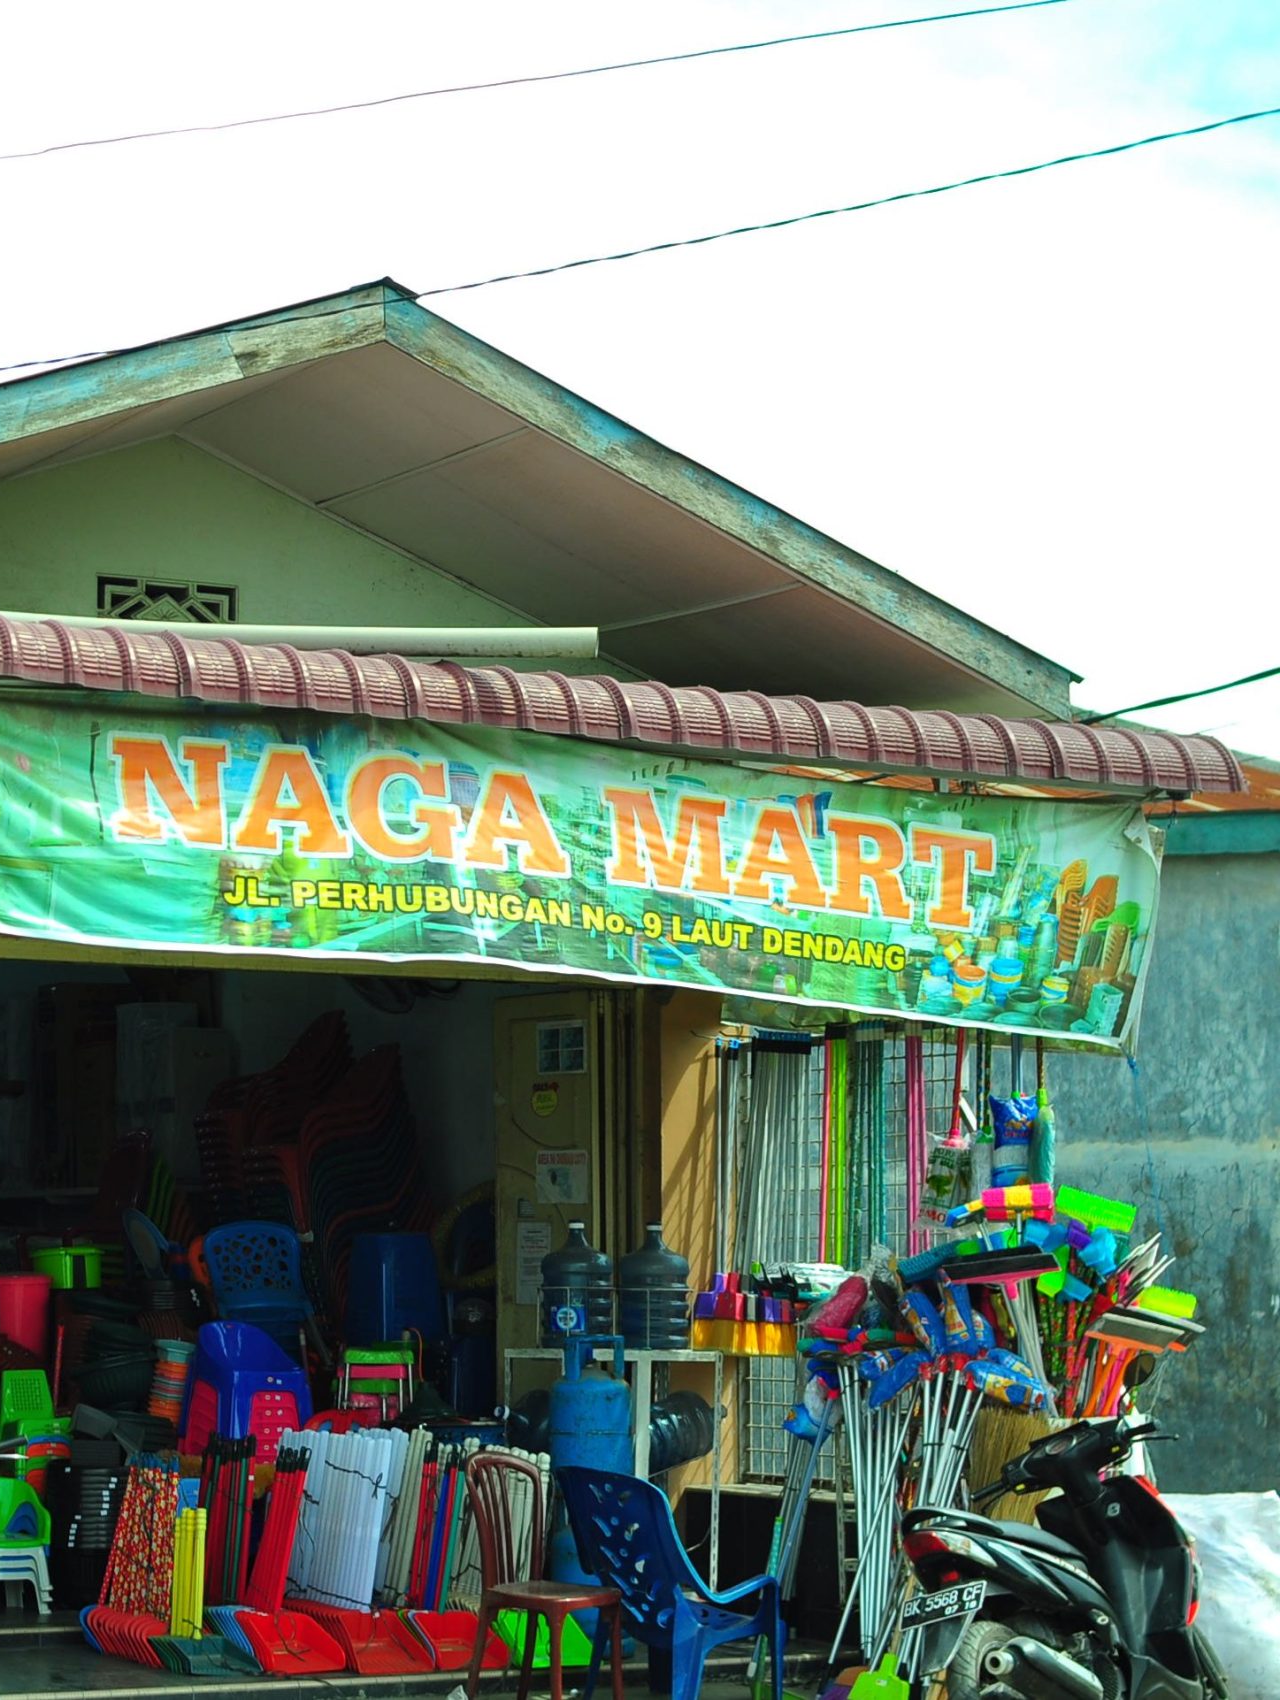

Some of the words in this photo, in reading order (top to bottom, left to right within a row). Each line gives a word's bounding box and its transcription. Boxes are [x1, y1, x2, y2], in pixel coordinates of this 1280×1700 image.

[108, 732, 570, 878] NAGA
[600, 785, 996, 931] MART
[223, 876, 281, 907] JL.
[291, 880, 571, 928] PERHUBUNGAN
[581, 903, 634, 936] No.
[642, 911, 662, 939] 9
[671, 915, 753, 951] LAUT
[762, 928, 907, 973] DENDANG
[903, 1598, 921, 1617] BK
[924, 1590, 959, 1612] 5568
[962, 1584, 982, 1601] CF
[944, 1604, 959, 1615] 07
